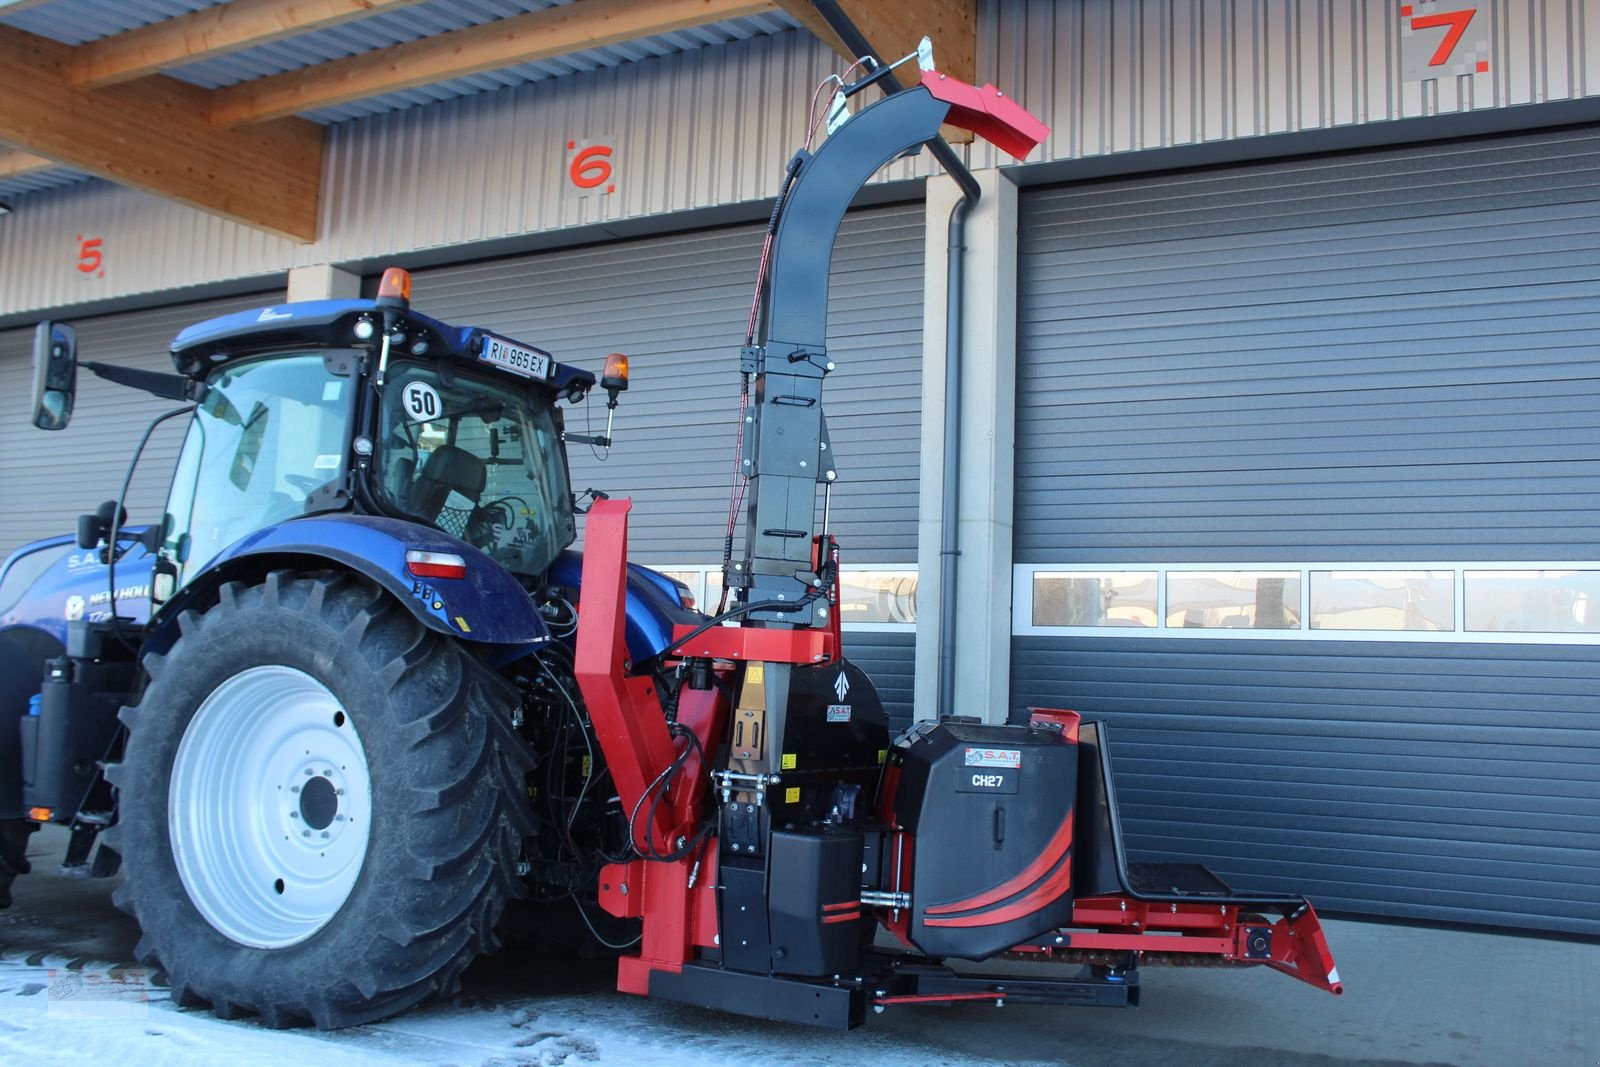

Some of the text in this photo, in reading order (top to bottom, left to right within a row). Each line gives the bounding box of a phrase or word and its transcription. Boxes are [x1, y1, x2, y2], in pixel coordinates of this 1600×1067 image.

[1411, 8, 1477, 67] 7
[570, 145, 612, 189] 6
[78, 239, 102, 273] 5
[491, 342, 544, 374] RI 965 EX
[410, 388, 435, 416] 50
[984, 750, 1019, 761] S.A.T.
[972, 774, 1003, 788] CH27
